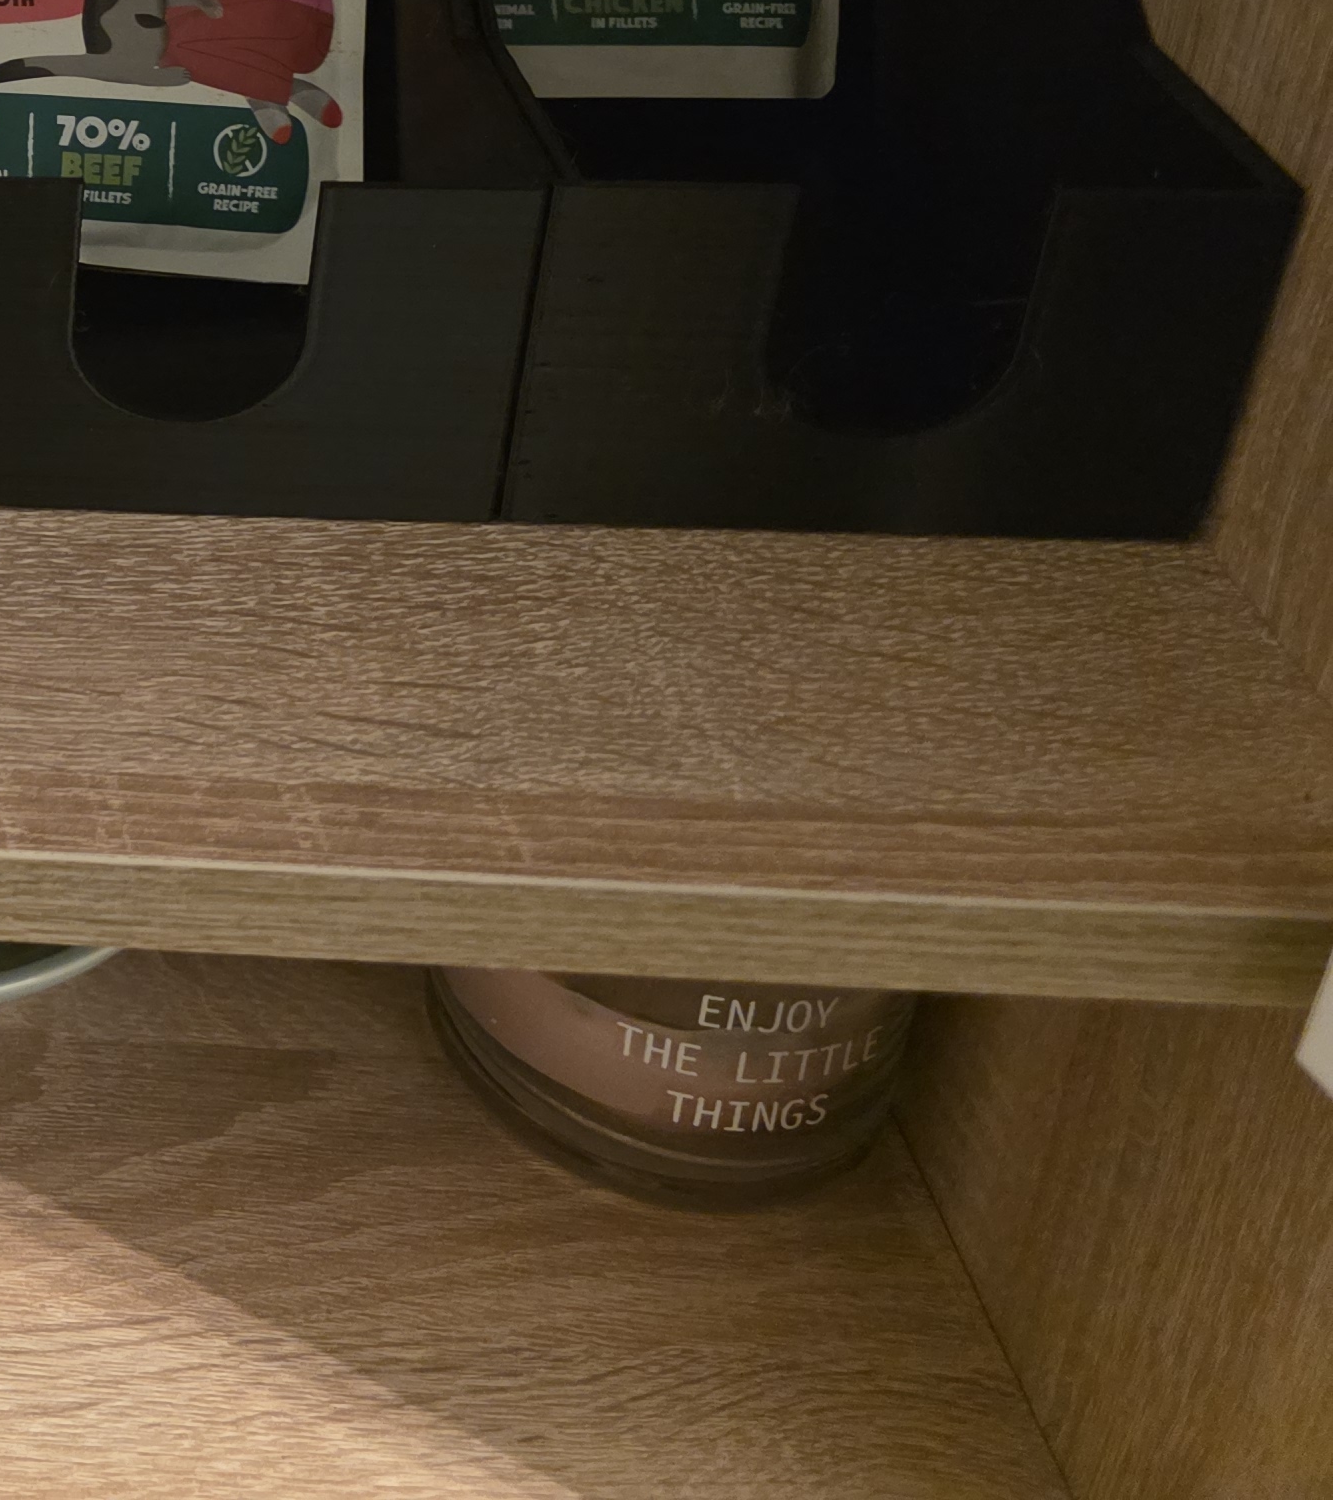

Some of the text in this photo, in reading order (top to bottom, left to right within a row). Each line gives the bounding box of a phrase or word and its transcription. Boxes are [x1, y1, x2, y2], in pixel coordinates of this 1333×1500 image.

[722, 2, 797, 15] GRAIN-FREE
[590, 15, 658, 30] IN FILLETS
[739, 16, 784, 30] RECIPE
[55, 114, 151, 152] 70%
[60, 151, 143, 187] BEEF
[82, 189, 133, 206] FILLETS
[197, 182, 279, 200] GRAIN-FREE
[212, 198, 260, 214] RECIPE
[697, 993, 840, 1035] ENJOY
[615, 1021, 884, 1085] THE LITTLE
[666, 1089, 830, 1133] THINGS
